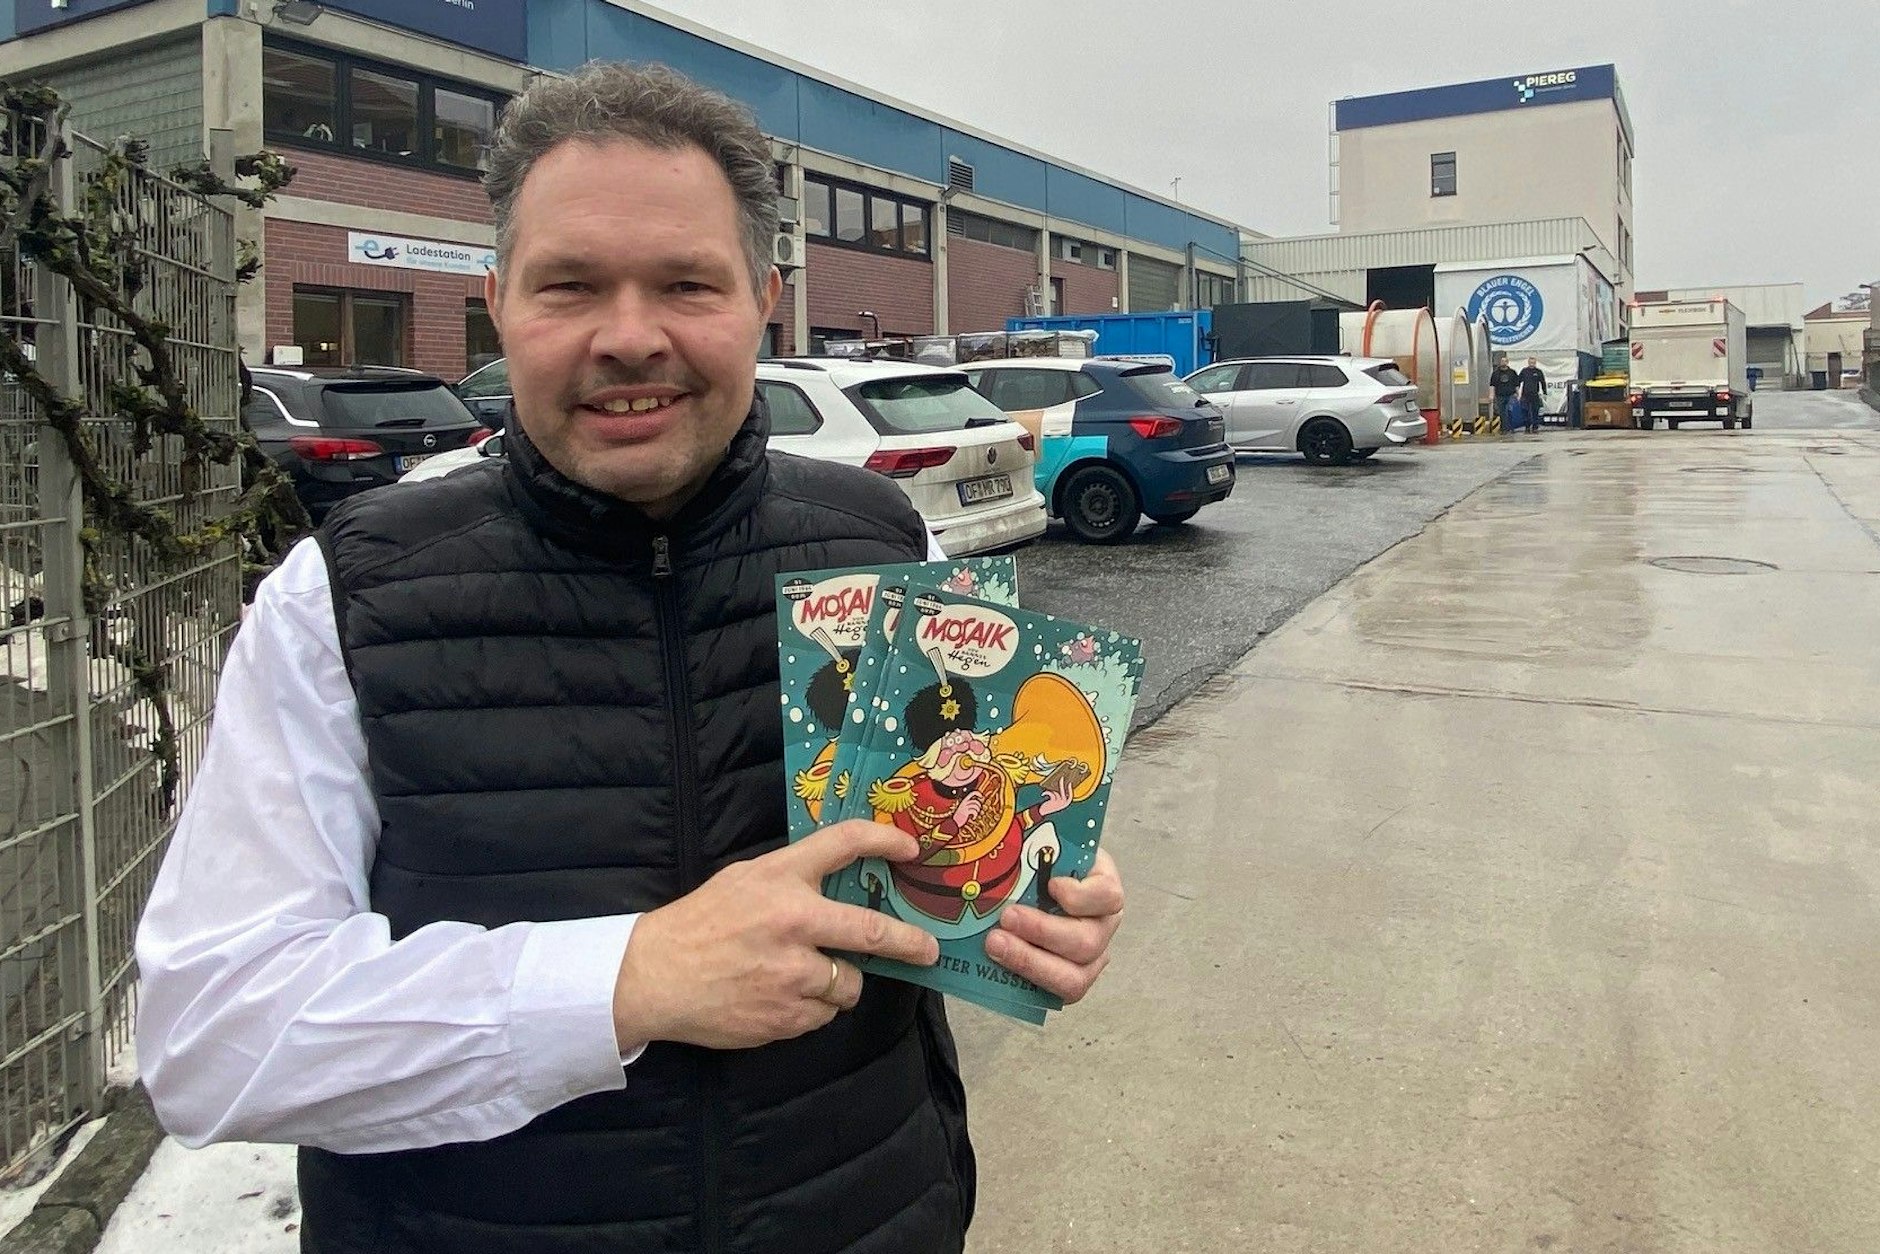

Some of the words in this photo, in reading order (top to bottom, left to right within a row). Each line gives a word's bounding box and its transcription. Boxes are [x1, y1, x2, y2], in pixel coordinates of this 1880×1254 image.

[445, 0, 474, 10] erlin
[1526, 71, 1576, 88] PIEREG
[406, 244, 471, 261] Ladestation
[1476, 277, 1509, 297] BLAUER
[1510, 277, 1535, 297] ENGEL
[1547, 381, 1567, 389] PIE
[800, 586, 873, 624] MOSAI
[833, 624, 868, 641] Heg
[922, 617, 1015, 651] MOSAIK
[947, 650, 991, 671] Hegen
[938, 955, 970, 974] TER
